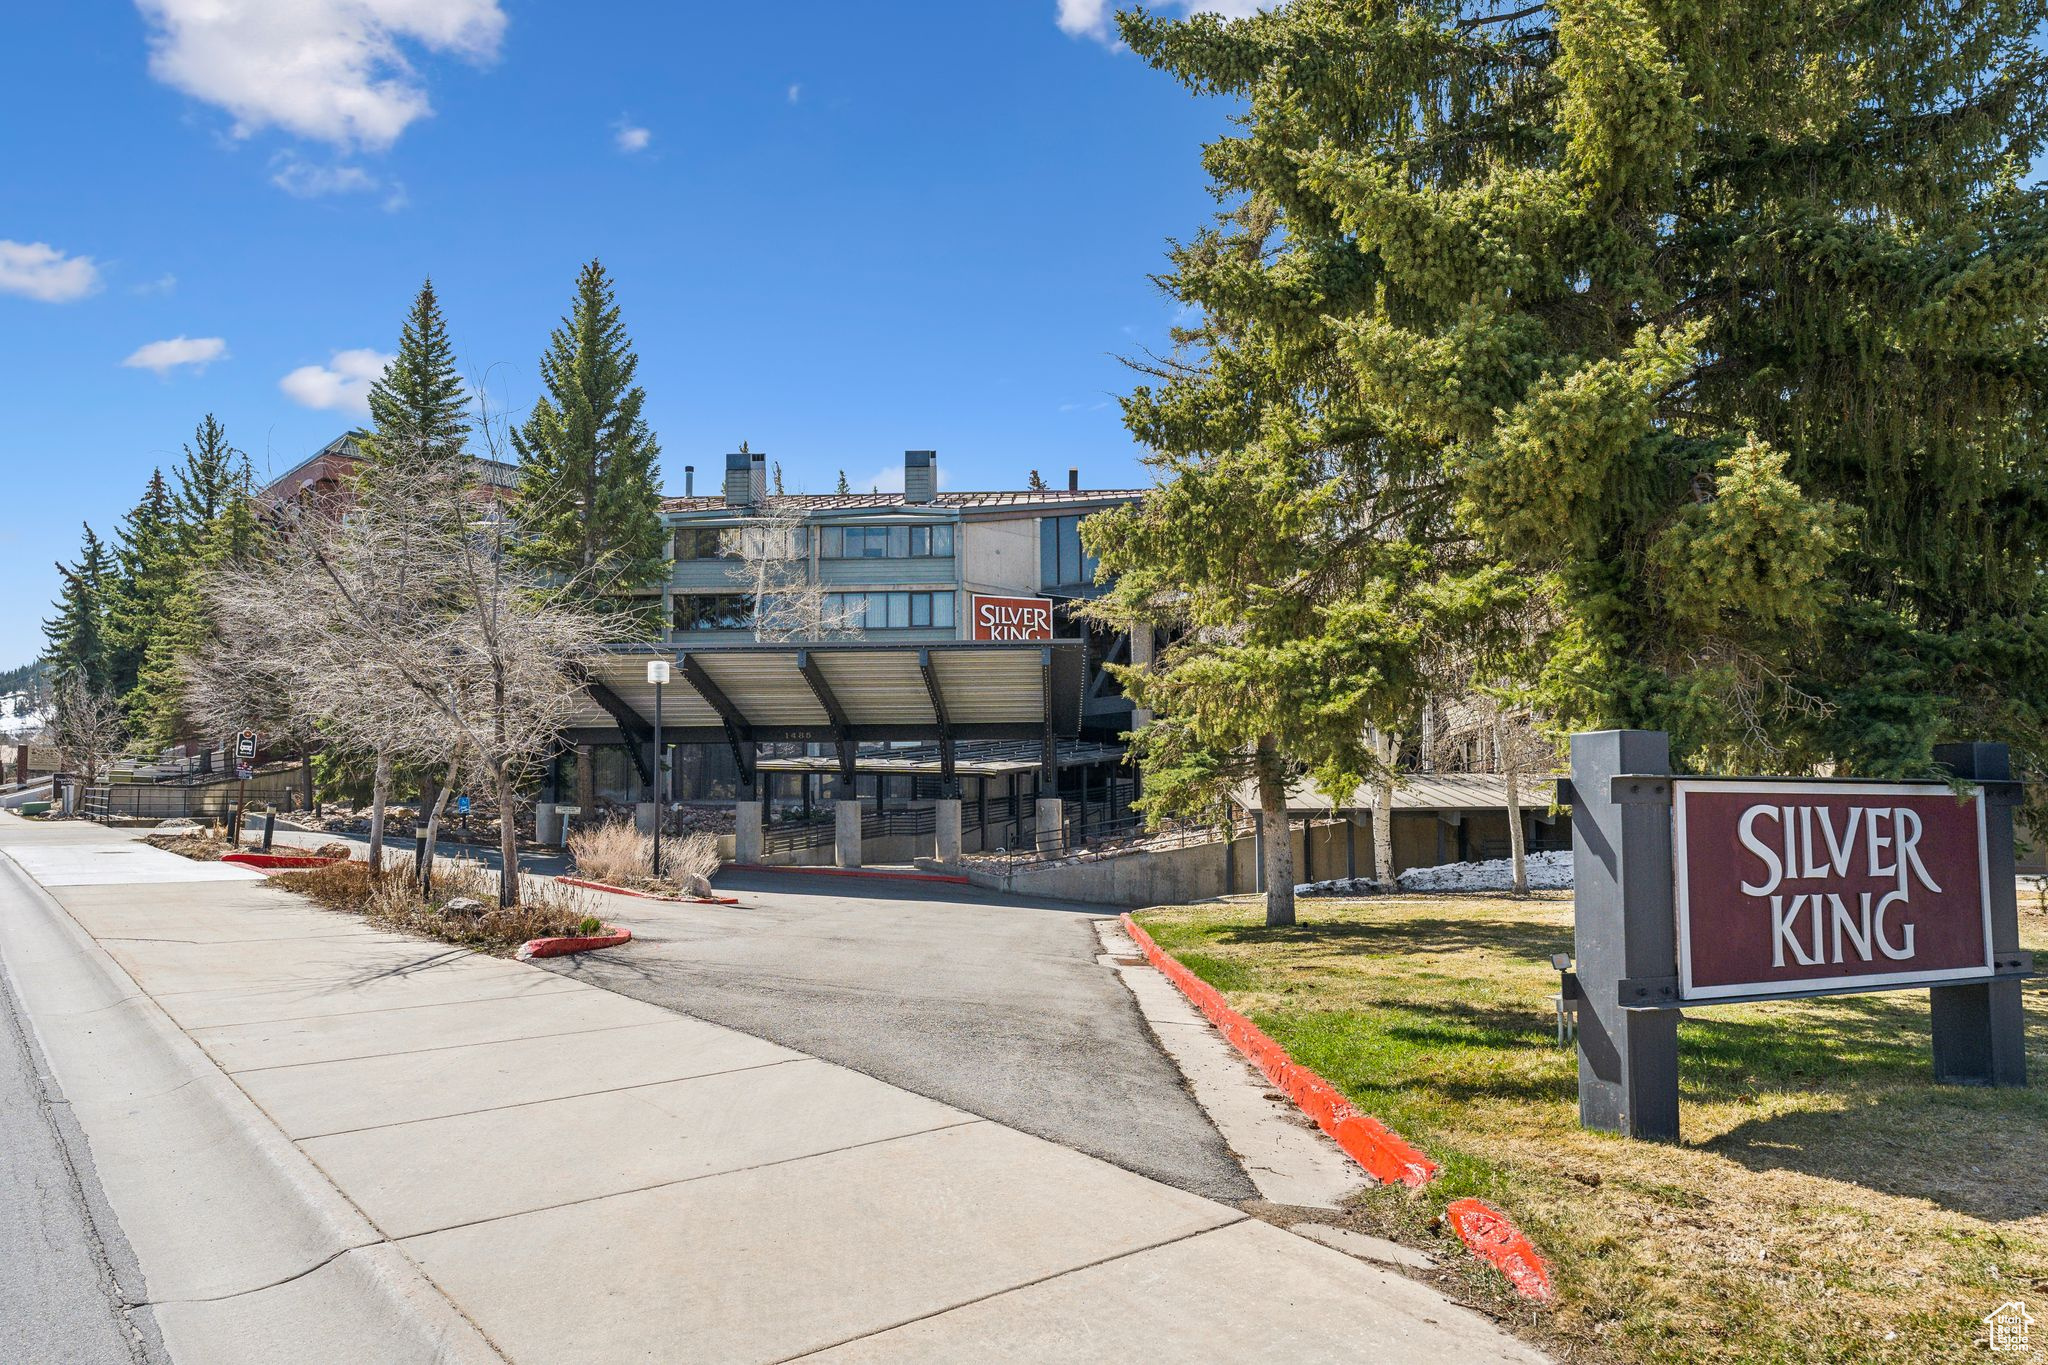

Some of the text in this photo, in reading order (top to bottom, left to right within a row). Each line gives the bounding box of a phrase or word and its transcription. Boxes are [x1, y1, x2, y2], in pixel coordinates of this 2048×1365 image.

[980, 604, 1050, 630] SILVER
[991, 625, 1041, 640] KING
[1737, 804, 1942, 903] SILVER
[1769, 890, 1915, 967] KING
